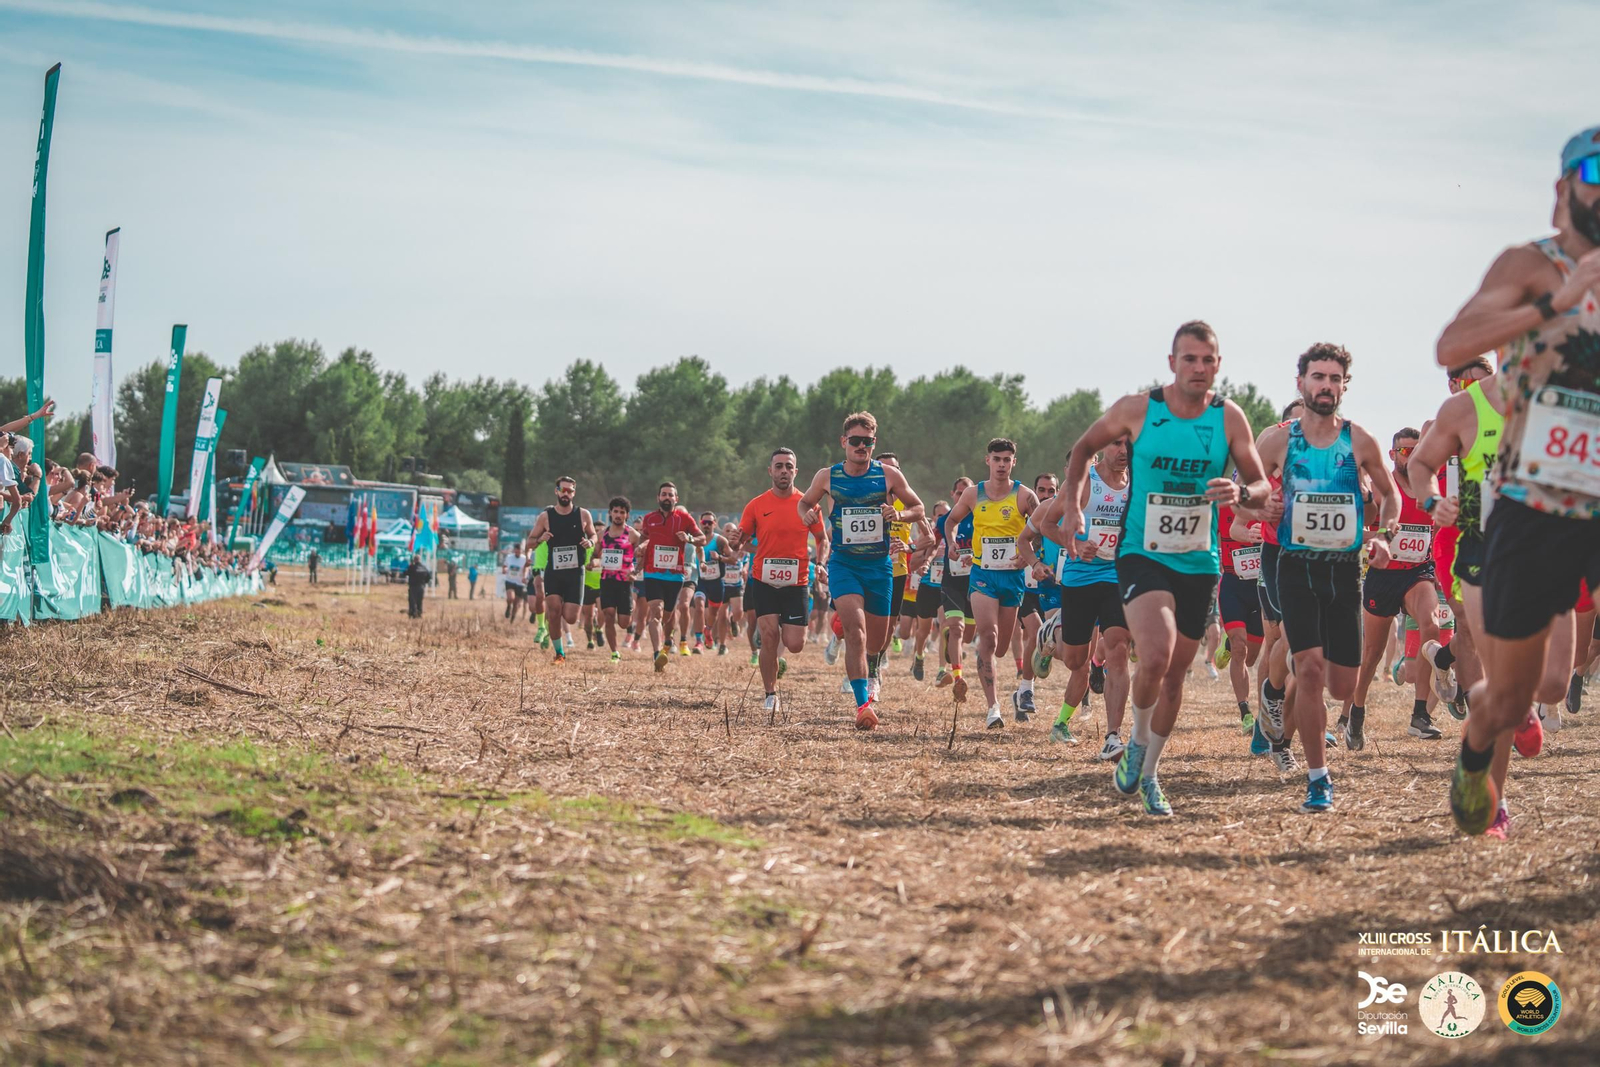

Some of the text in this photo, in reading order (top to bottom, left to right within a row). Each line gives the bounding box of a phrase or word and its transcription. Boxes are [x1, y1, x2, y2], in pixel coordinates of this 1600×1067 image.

[1151, 456, 1211, 473] ATLEET
[851, 520, 876, 533] 619
[1159, 515, 1201, 535] 847
[1305, 512, 1346, 531] 510
[1399, 538, 1425, 552] 640
[558, 554, 573, 563] 357
[604, 556, 619, 564] 248
[658, 554, 674, 562] 107
[992, 548, 1006, 560] 87
[769, 569, 792, 581] 549
